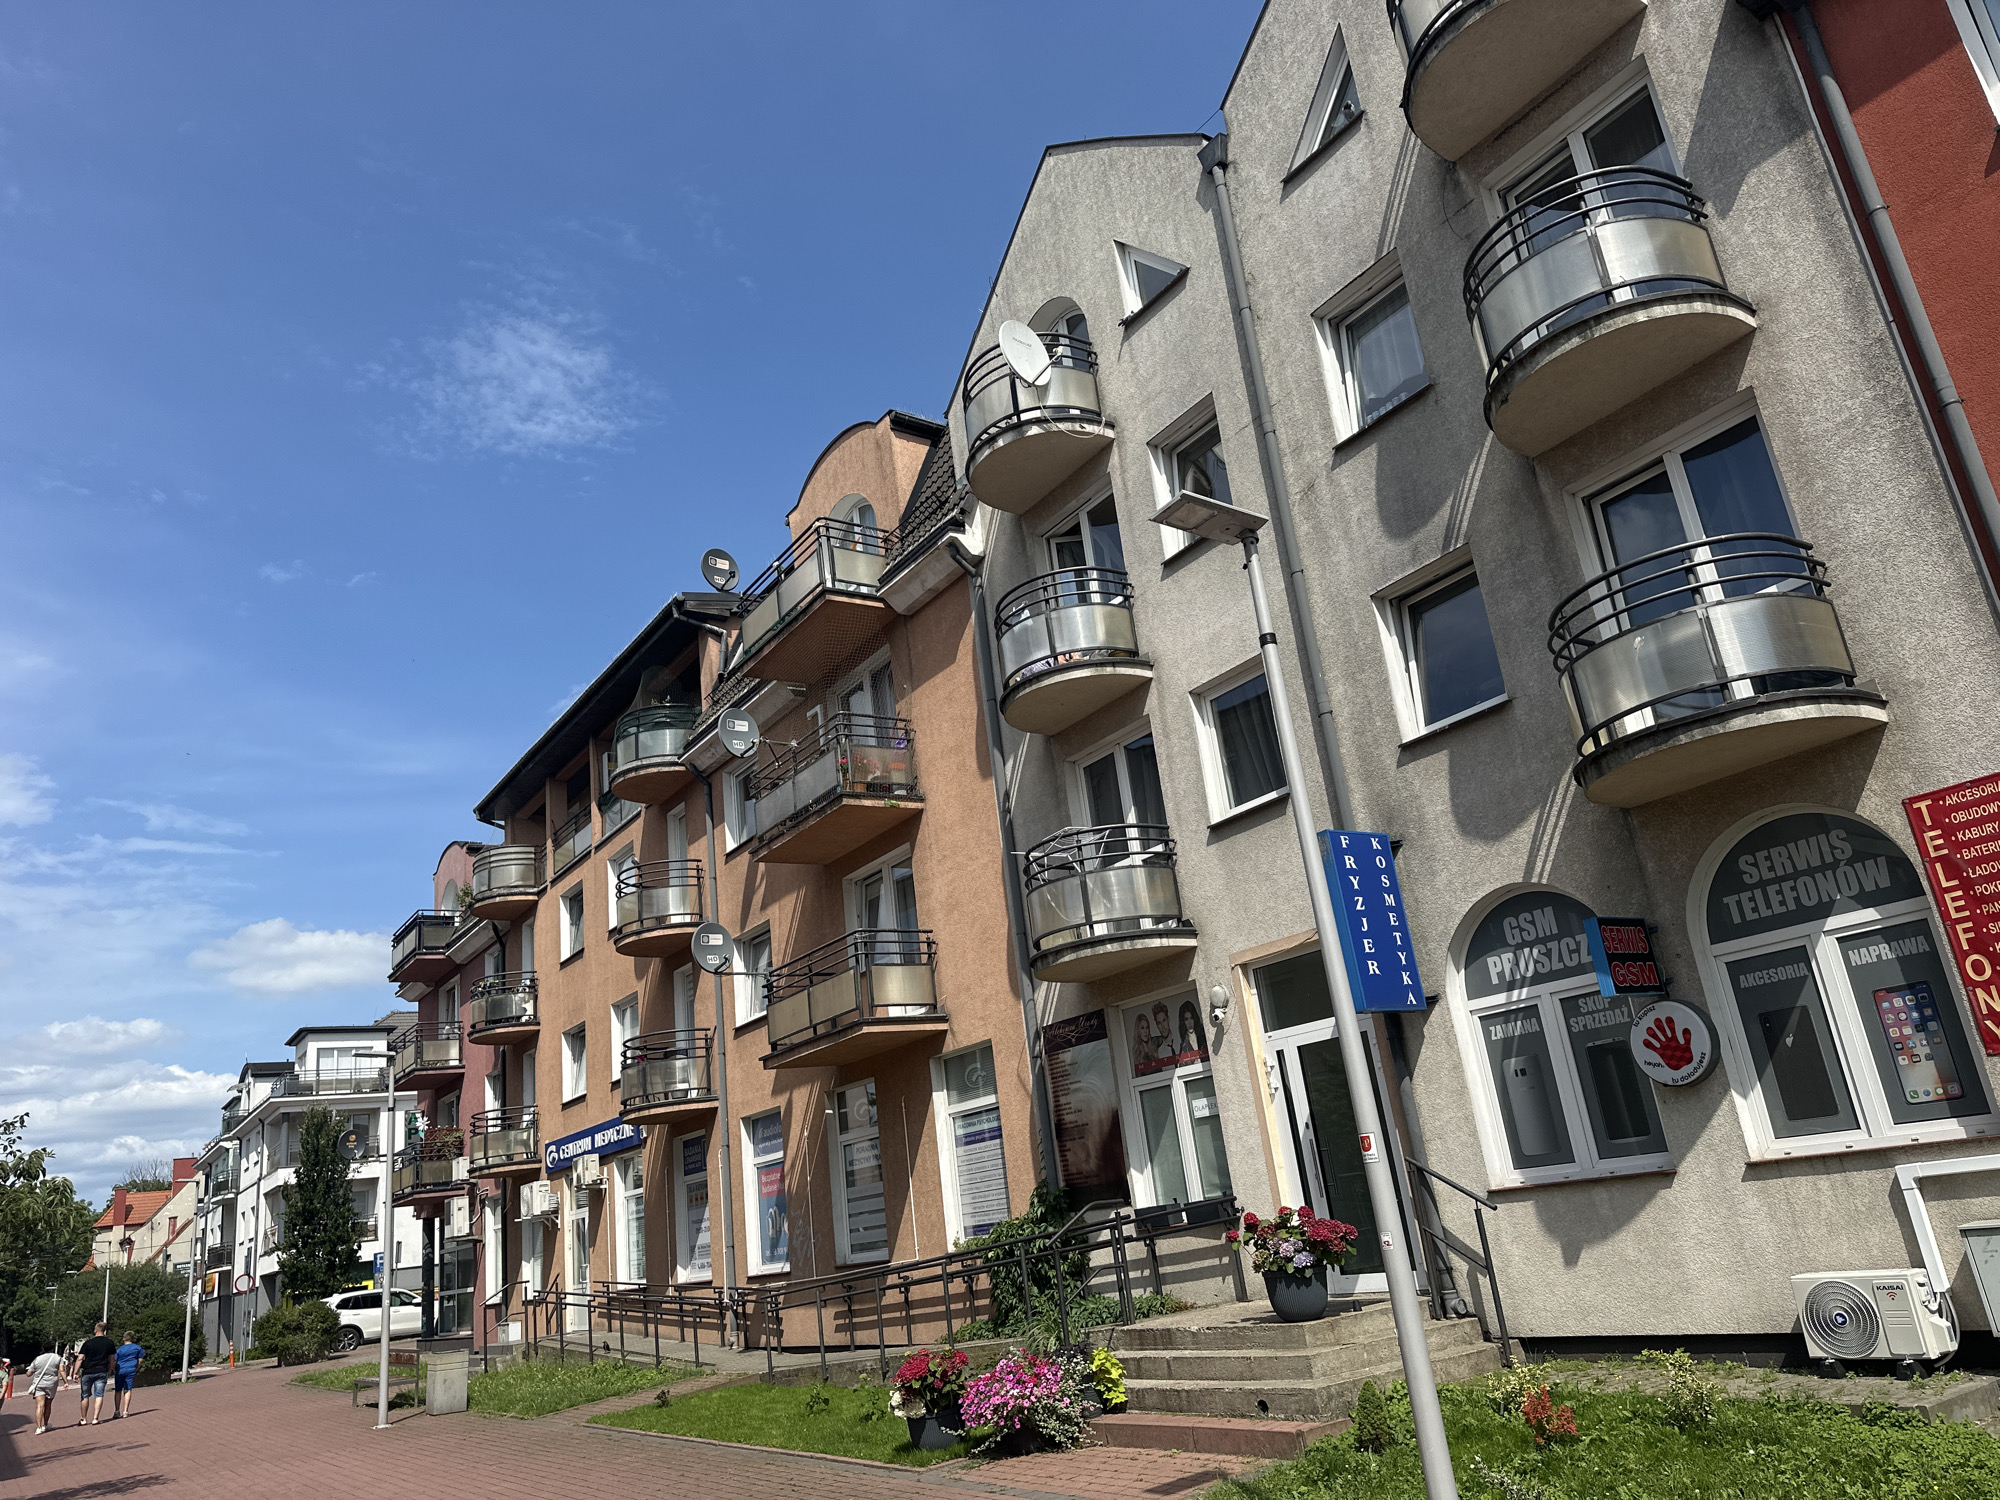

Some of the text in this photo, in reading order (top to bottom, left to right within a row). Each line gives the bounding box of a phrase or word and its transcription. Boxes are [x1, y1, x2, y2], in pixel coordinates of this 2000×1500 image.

[1956, 821, 1999, 841] KABURY
[1738, 829, 1853, 884] SERWIS
[1962, 840, 2000, 860] BATERI
[1722, 856, 1891, 925] TELEFONÓW
[1339, 835, 1382, 976] FRYZJER
[1370, 837, 1417, 1005] KOSMETYKA
[1502, 906, 1559, 946] GSM
[1601, 925, 1649, 954] SERWIS
[1848, 935, 1931, 966] NAPRAWA
[1486, 933, 1593, 985] PRUSZCZ
[1611, 961, 1660, 987] GSM
[1739, 962, 1810, 989] AKCESORIA
[1569, 1004, 1631, 1033] SPRZEDAŻ
[1578, 996, 1612, 1013] SKUP
[1632, 1005, 1656, 1027] tu kupisz
[1489, 1018, 1540, 1041] ZAMIANA
[560, 1124, 634, 1159] CENTRUM MEDYCZNE
